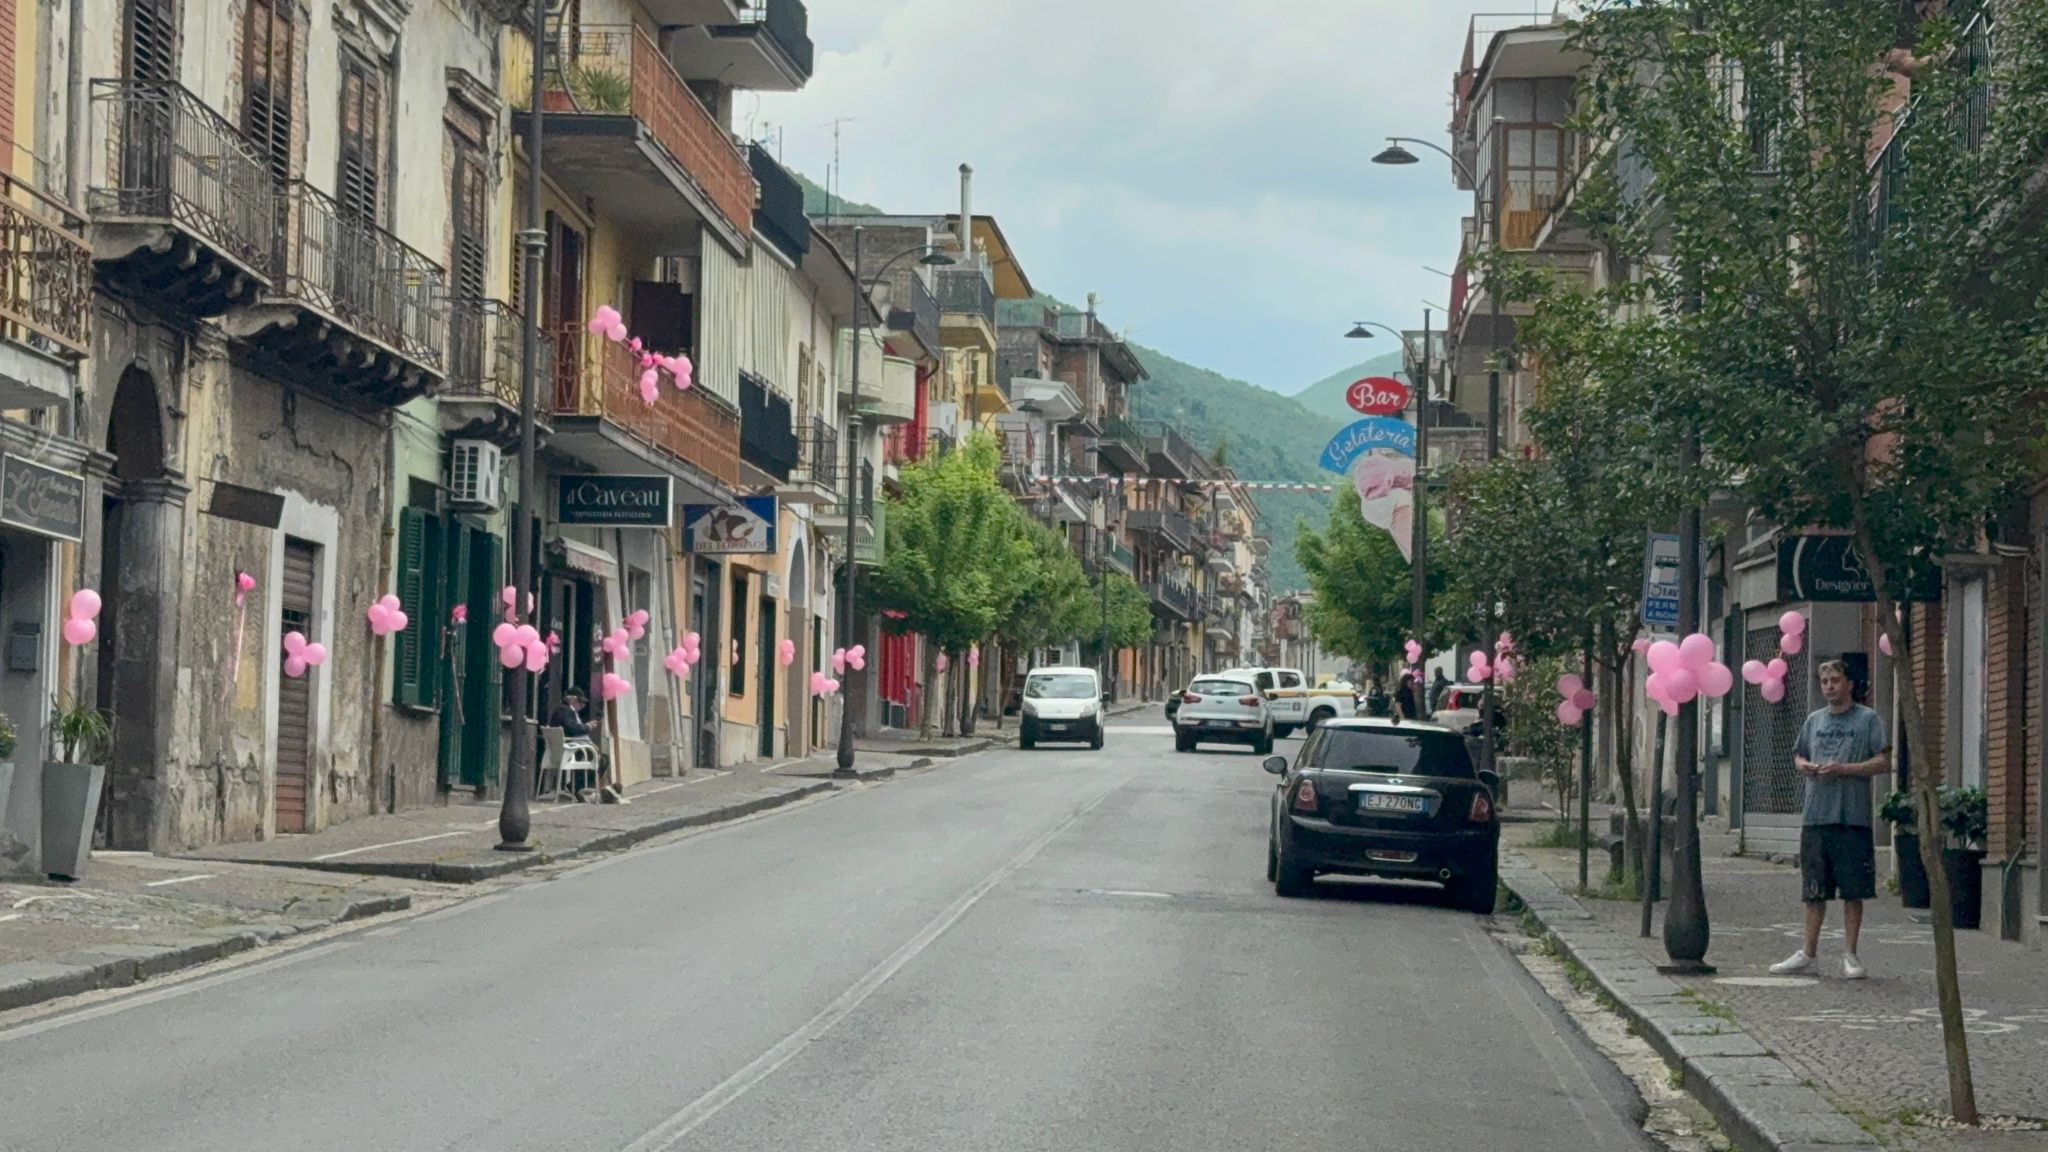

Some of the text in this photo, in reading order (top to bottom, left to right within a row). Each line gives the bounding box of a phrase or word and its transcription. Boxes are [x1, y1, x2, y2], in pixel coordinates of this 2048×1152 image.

[1352, 383, 1401, 408] Bar
[1328, 421, 1410, 468] Gelateria
[577, 481, 660, 506] Caveau
[1815, 578, 1871, 593] Designer
